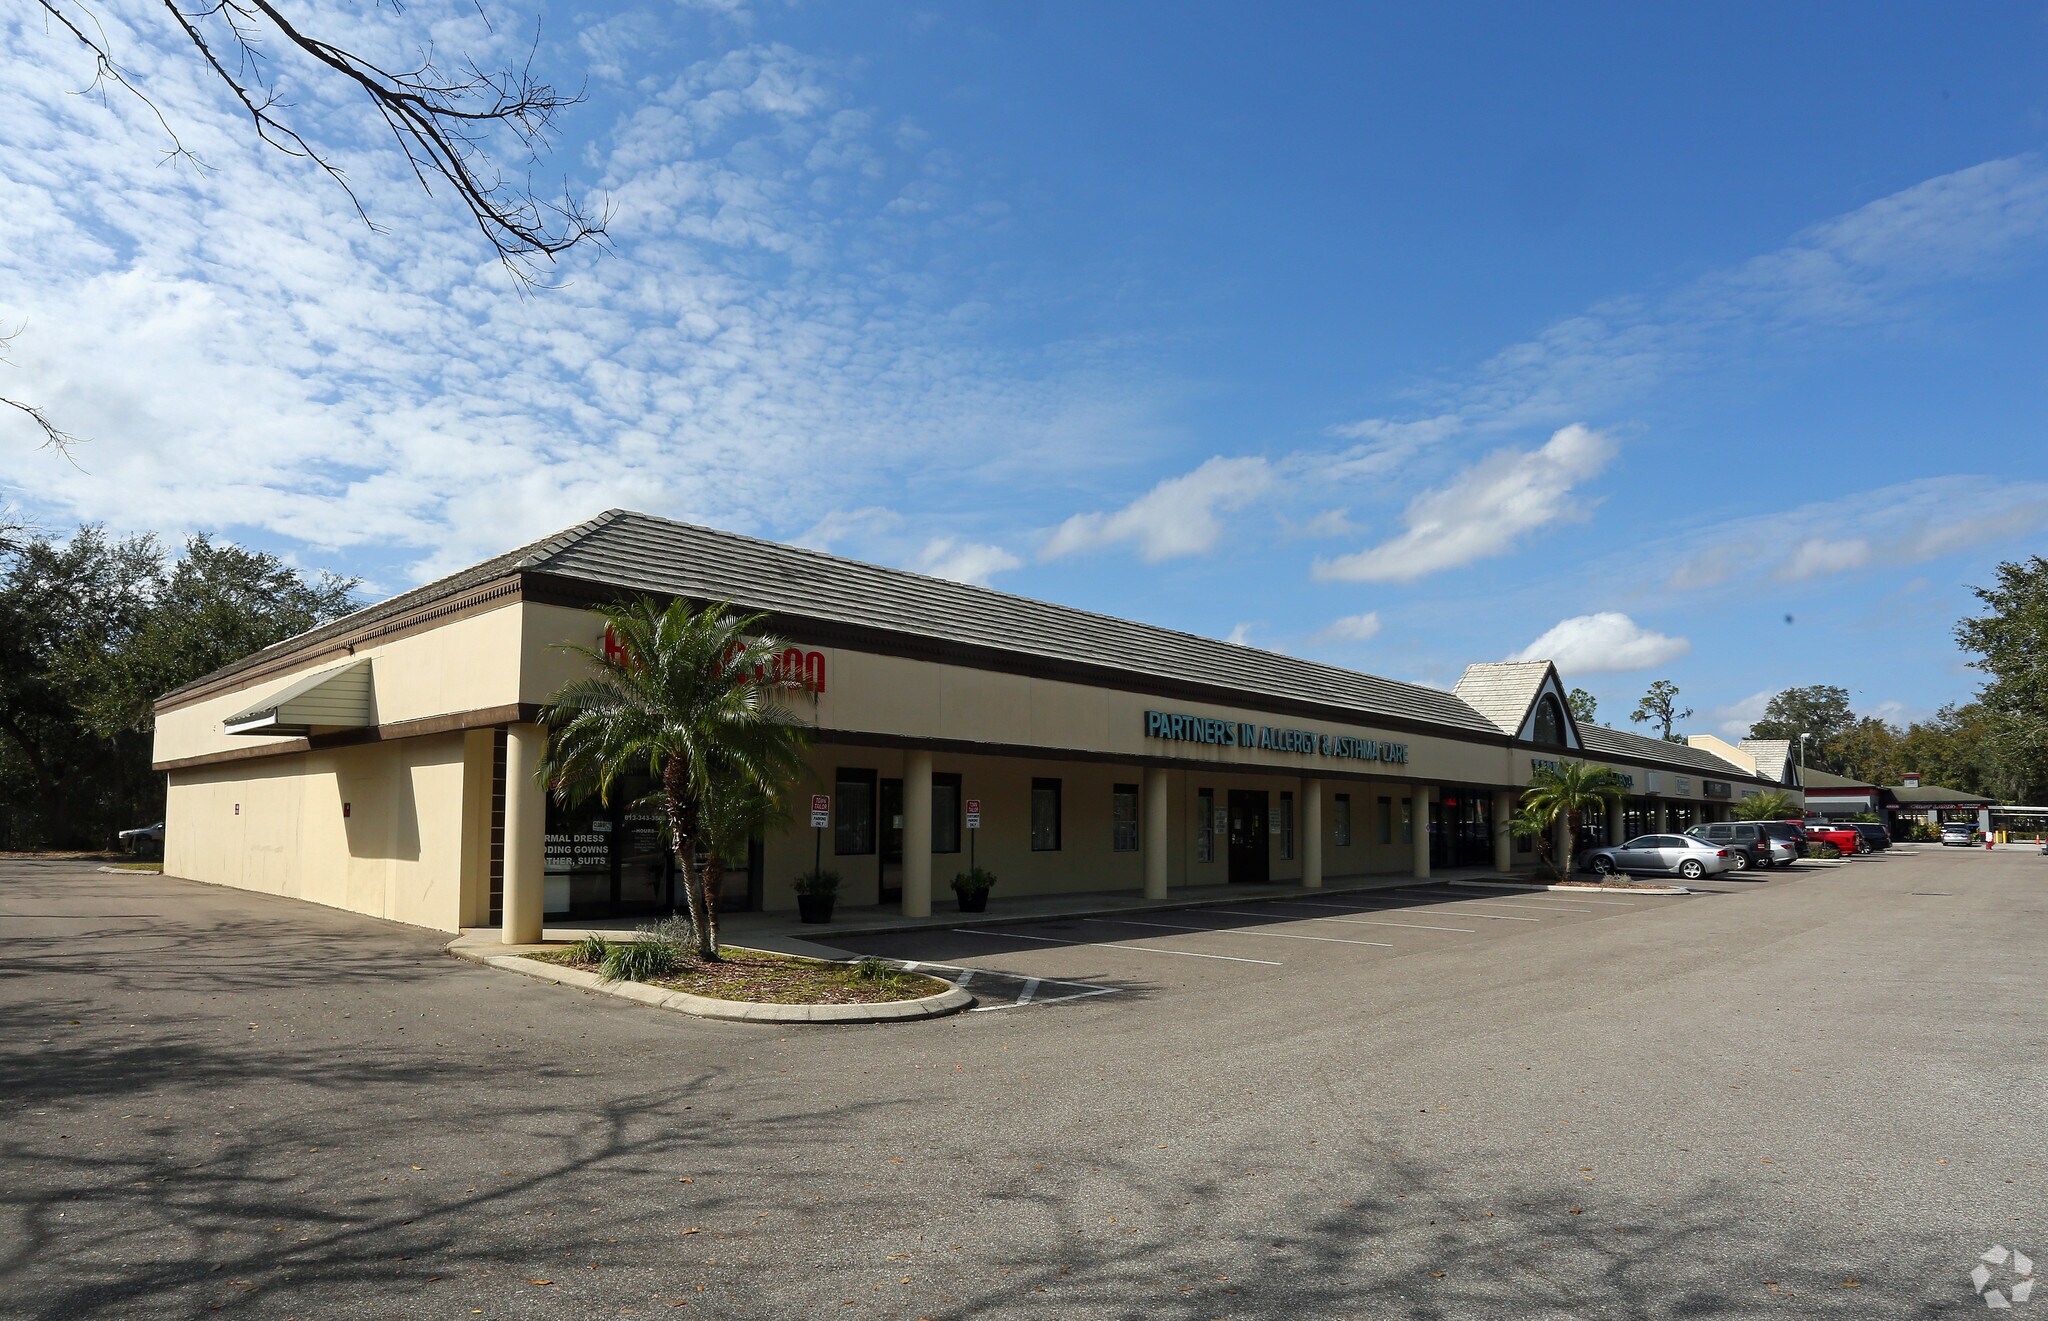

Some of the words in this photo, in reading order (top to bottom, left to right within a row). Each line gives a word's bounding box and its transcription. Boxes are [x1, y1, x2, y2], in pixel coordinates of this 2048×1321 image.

[1145, 711, 1236, 746] PARTNERS
[1239, 723, 1257, 748] IN
[1259, 726, 1319, 754] ALLERGY
[1321, 735, 1332, 757] &
[1332, 736, 1379, 761] ASTHMA
[1380, 742, 1410, 765] CARE
[573, 834, 605, 843] DRESS
[574, 845, 609, 854] GOWNS
[577, 856, 606, 865] SUITS
